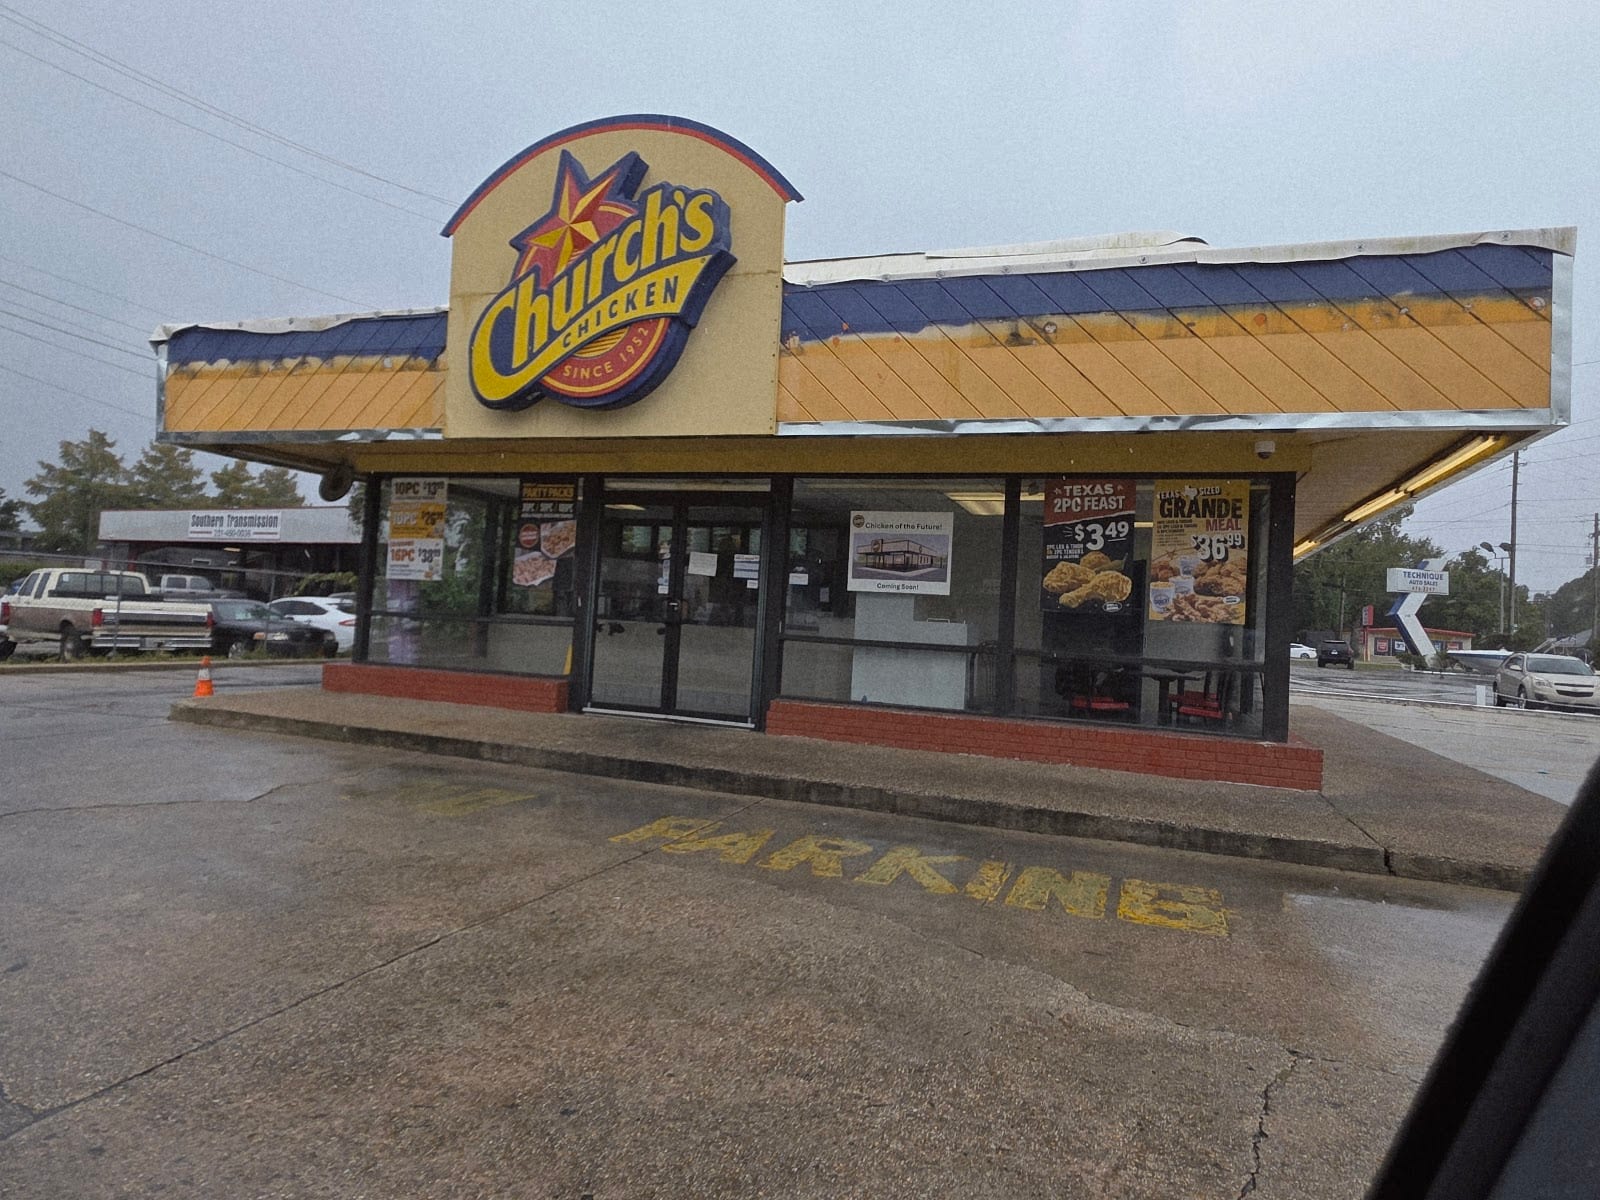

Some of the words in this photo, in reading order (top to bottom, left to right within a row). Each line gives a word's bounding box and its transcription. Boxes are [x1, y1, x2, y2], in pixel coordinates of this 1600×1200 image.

[471, 190, 715, 400] Church's
[562, 276, 679, 348] CHICKEN
[563, 361, 613, 379] SINCE
[620, 328, 649, 362] 1952
[394, 482, 420, 495] 10PC
[1063, 483, 1114, 497] TEXAS
[1199, 486, 1221, 495] SIZED
[1054, 497, 1081, 513] 2PC
[1084, 496, 1125, 511] FEAST
[1159, 498, 1243, 519] GRANDE
[191, 514, 224, 528] Southern
[227, 514, 278, 528] Transmission
[1205, 519, 1242, 532] MEAL
[391, 549, 415, 562] 16PC
[1403, 571, 1444, 580] TECHNIQUE
[609, 815, 1229, 936] PARKING
